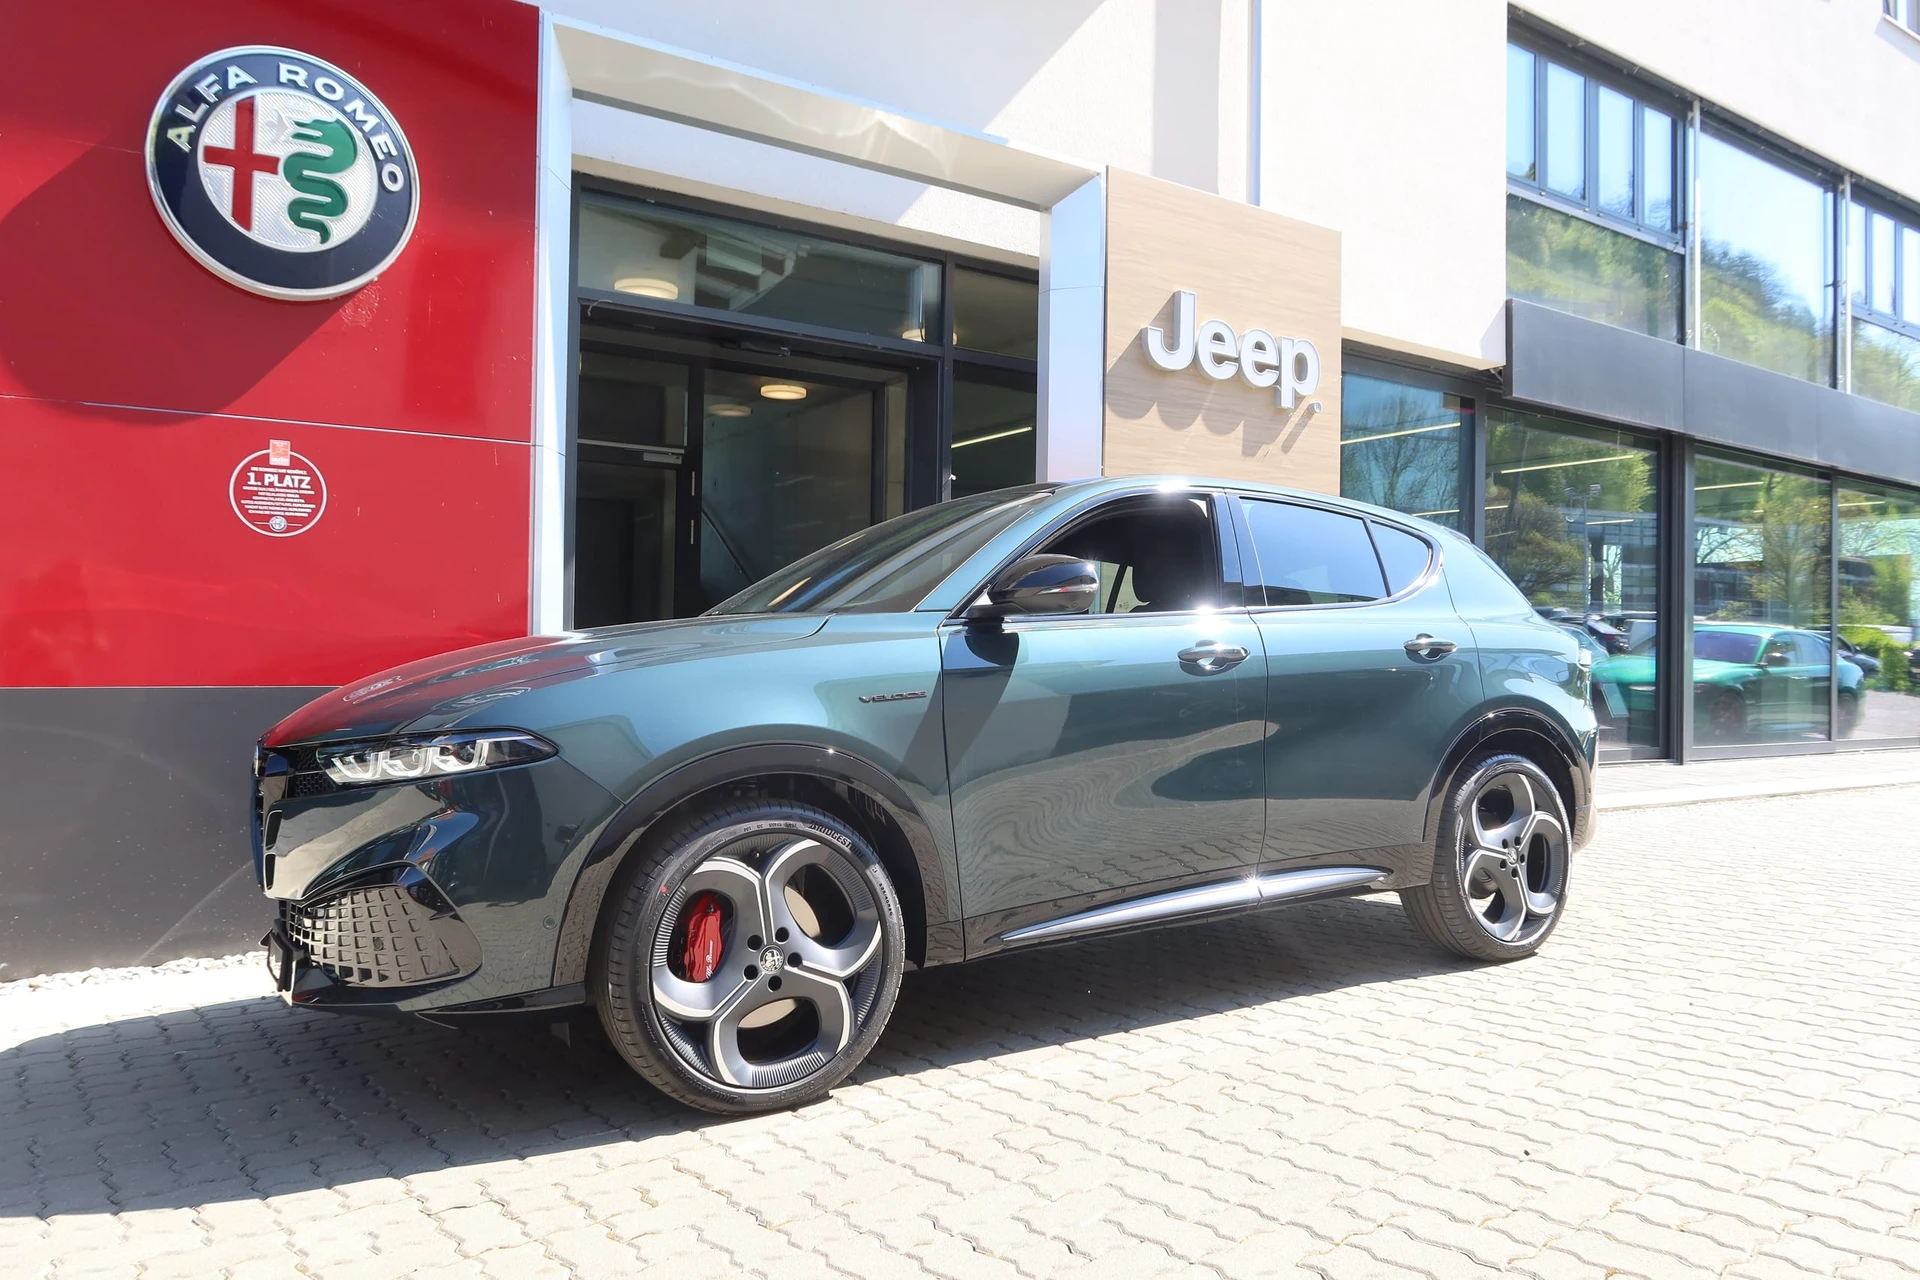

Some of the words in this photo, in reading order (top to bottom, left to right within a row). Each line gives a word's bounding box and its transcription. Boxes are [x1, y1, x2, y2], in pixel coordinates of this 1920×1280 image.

[167, 65, 257, 153] ALFA
[279, 62, 404, 192] ROMEO
[1141, 290, 1321, 409] Jeep
[247, 472, 262, 485] 1.
[264, 474, 311, 489] PLATZ
[808, 821, 865, 860] BRIDGESTONE
